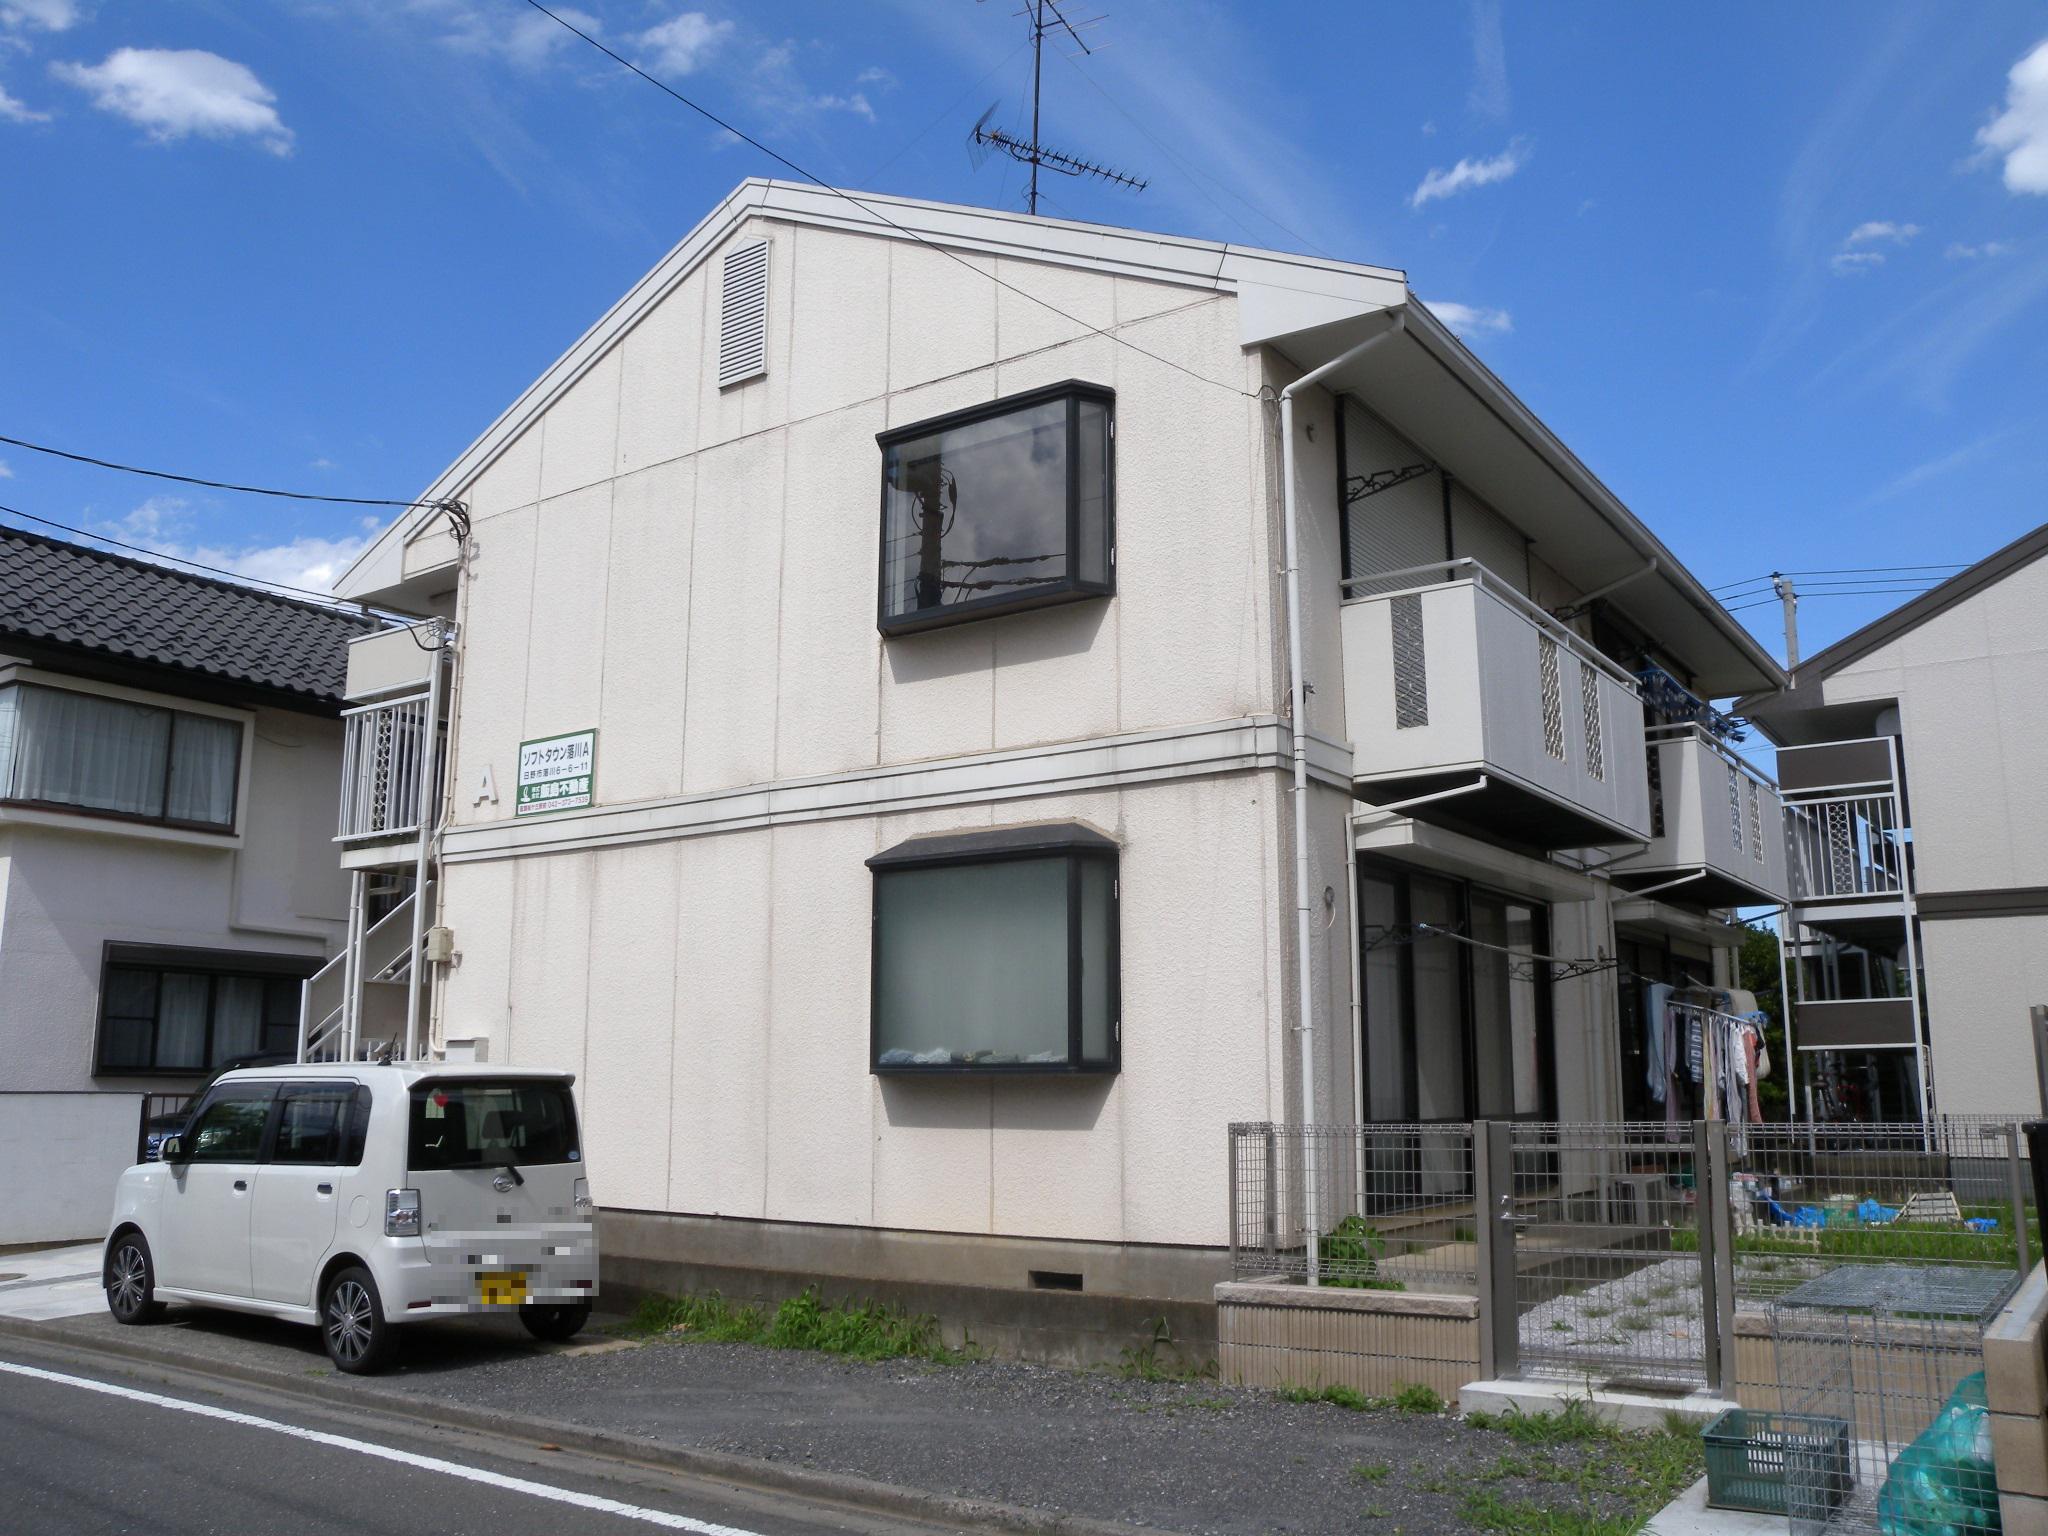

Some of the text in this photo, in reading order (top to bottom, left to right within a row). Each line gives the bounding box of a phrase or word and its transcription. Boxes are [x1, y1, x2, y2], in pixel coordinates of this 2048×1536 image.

[524, 741, 590, 767] ソフトタウン落川A
[472, 764, 499, 808] A
